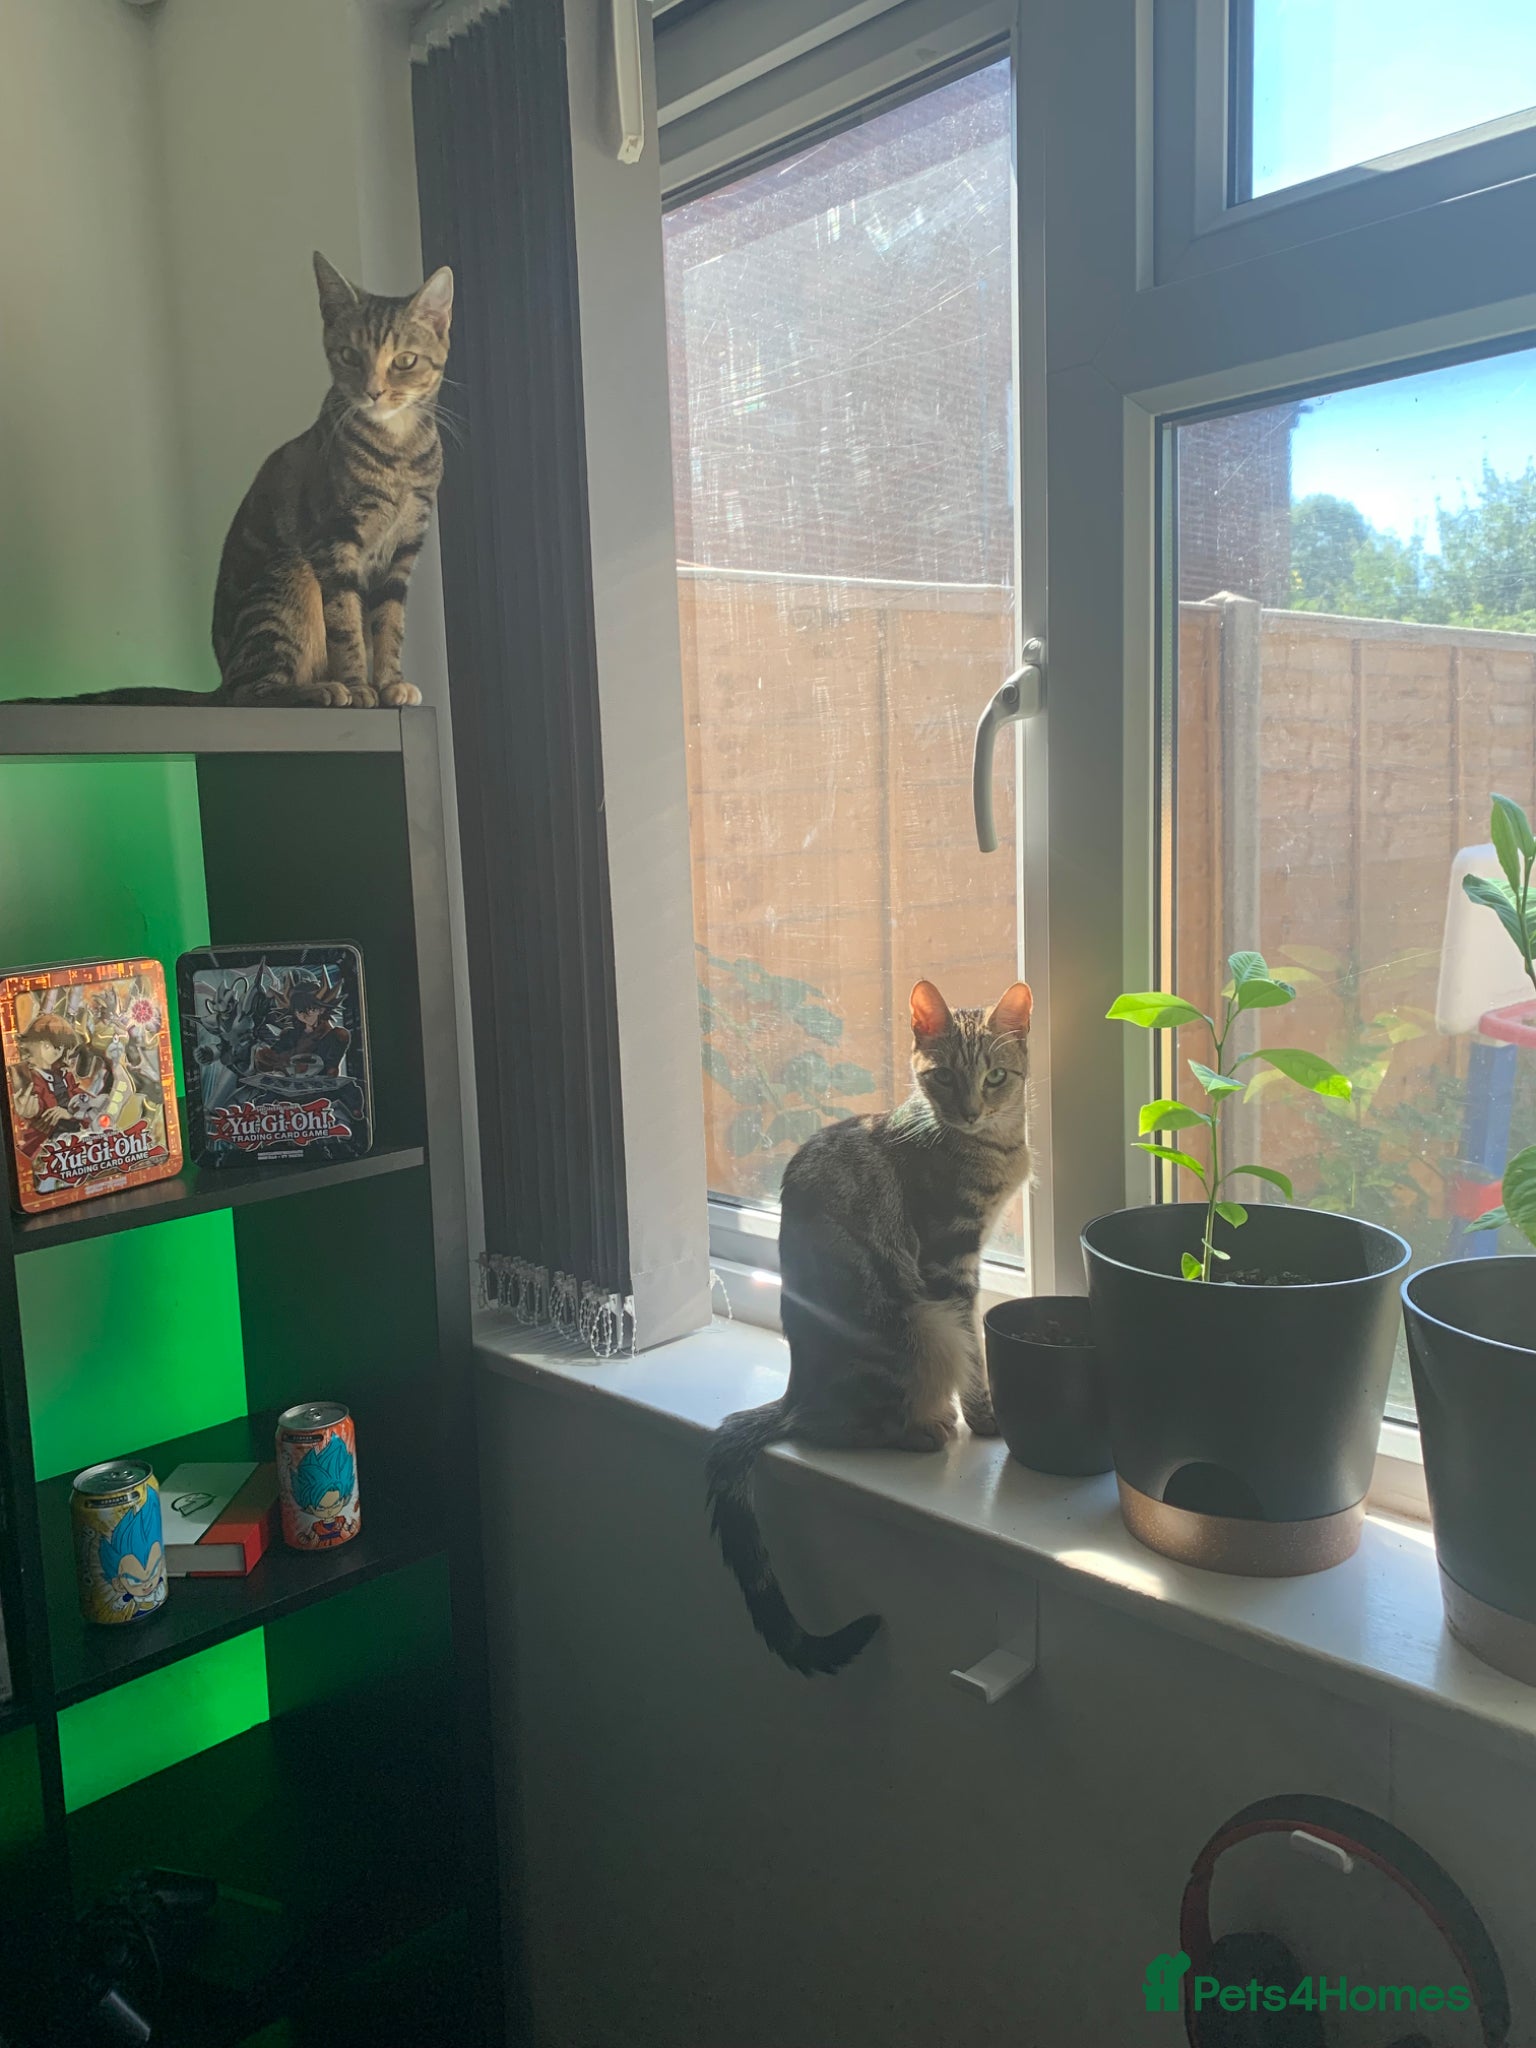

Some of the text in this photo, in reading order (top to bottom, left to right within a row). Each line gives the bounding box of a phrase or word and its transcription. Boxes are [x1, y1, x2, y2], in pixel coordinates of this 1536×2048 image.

[232, 1129, 329, 1142] TRADING CARD GAME
[60, 1152, 149, 1179] TRADING CARD GAME
